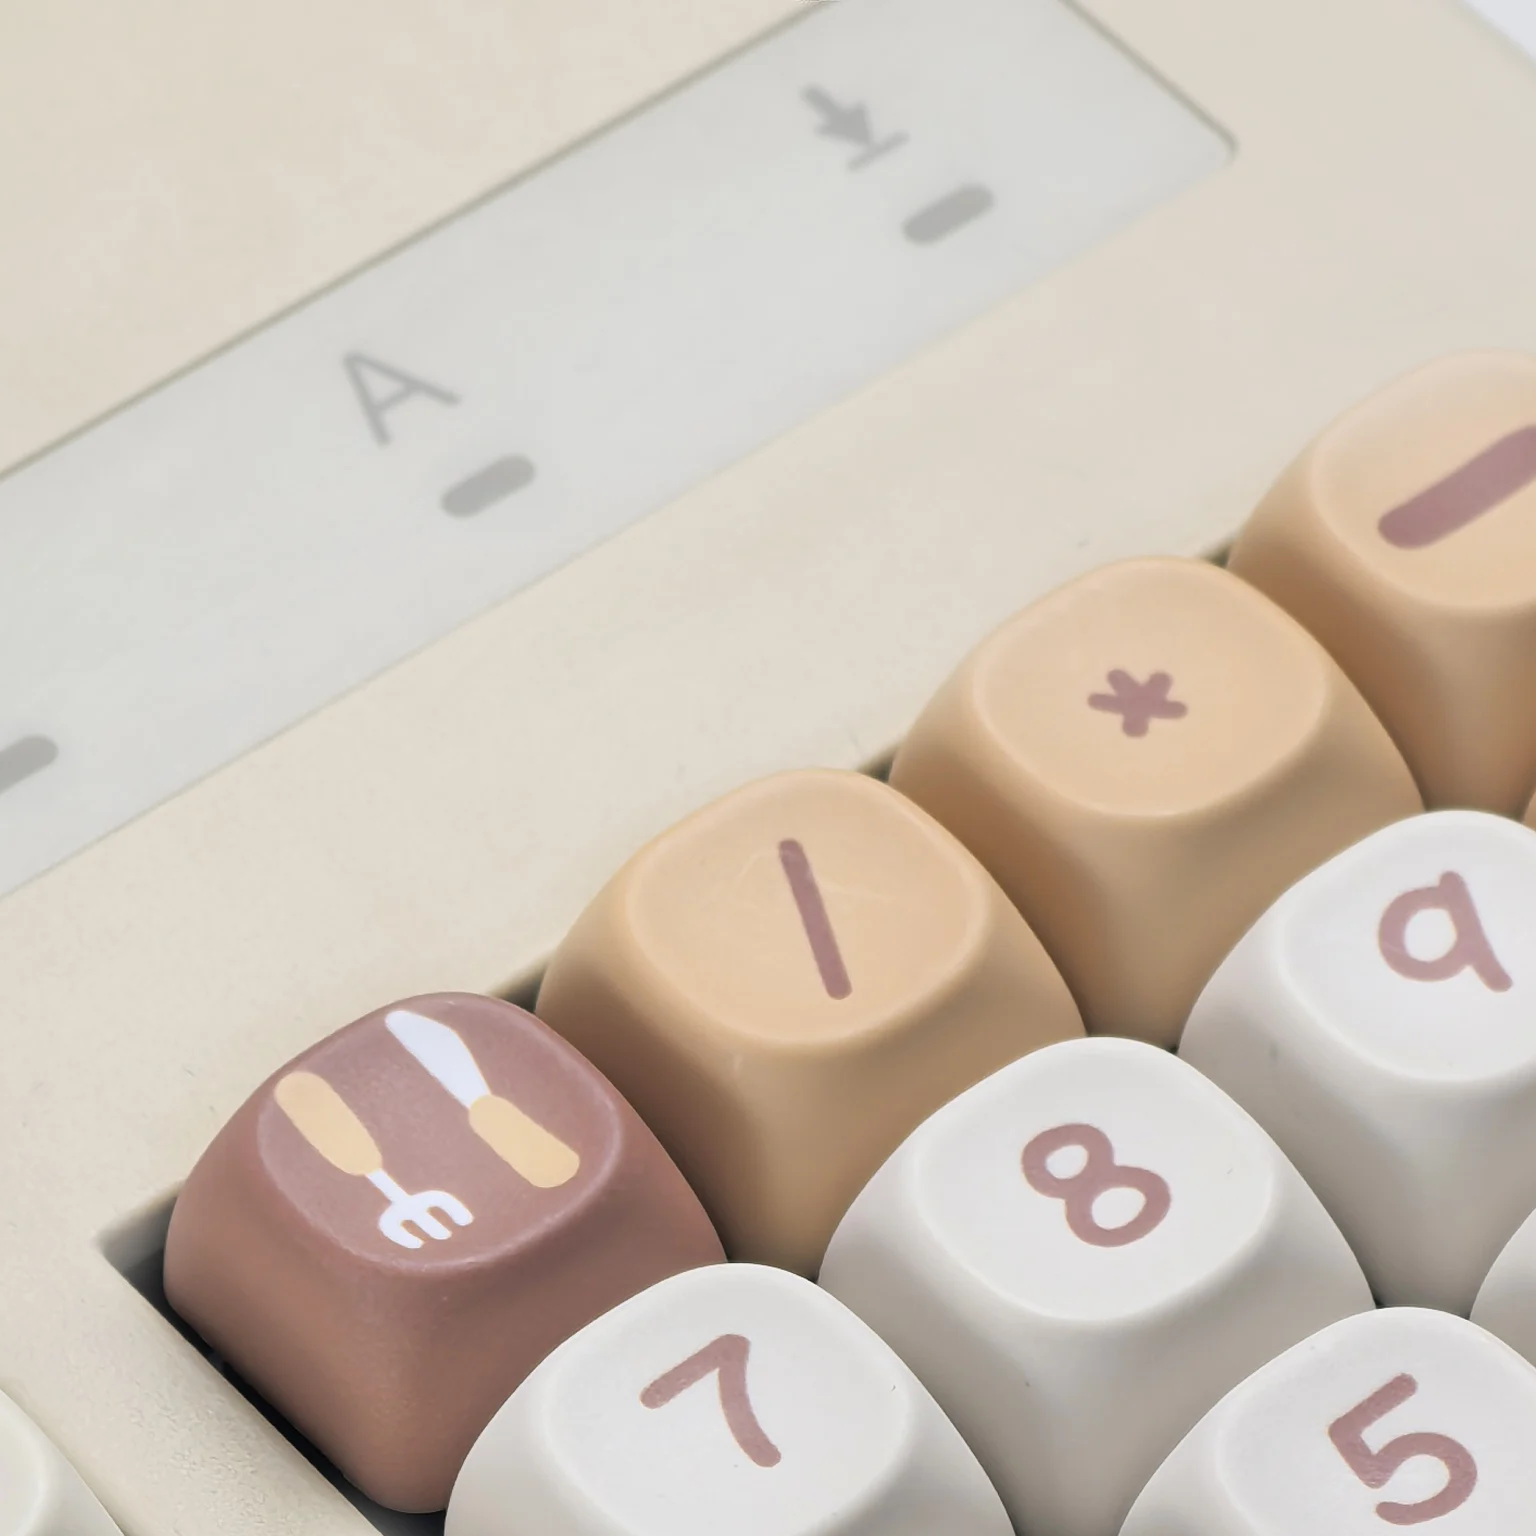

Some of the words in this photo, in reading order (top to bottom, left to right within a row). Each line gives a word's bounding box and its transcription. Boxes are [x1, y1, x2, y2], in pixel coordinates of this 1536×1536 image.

[342, 351, 460, 445] A
[1377, 870, 1513, 992] 9
[1020, 1122, 1172, 1248] 8
[639, 1333, 782, 1468] 7
[1327, 1372, 1478, 1526] 5
